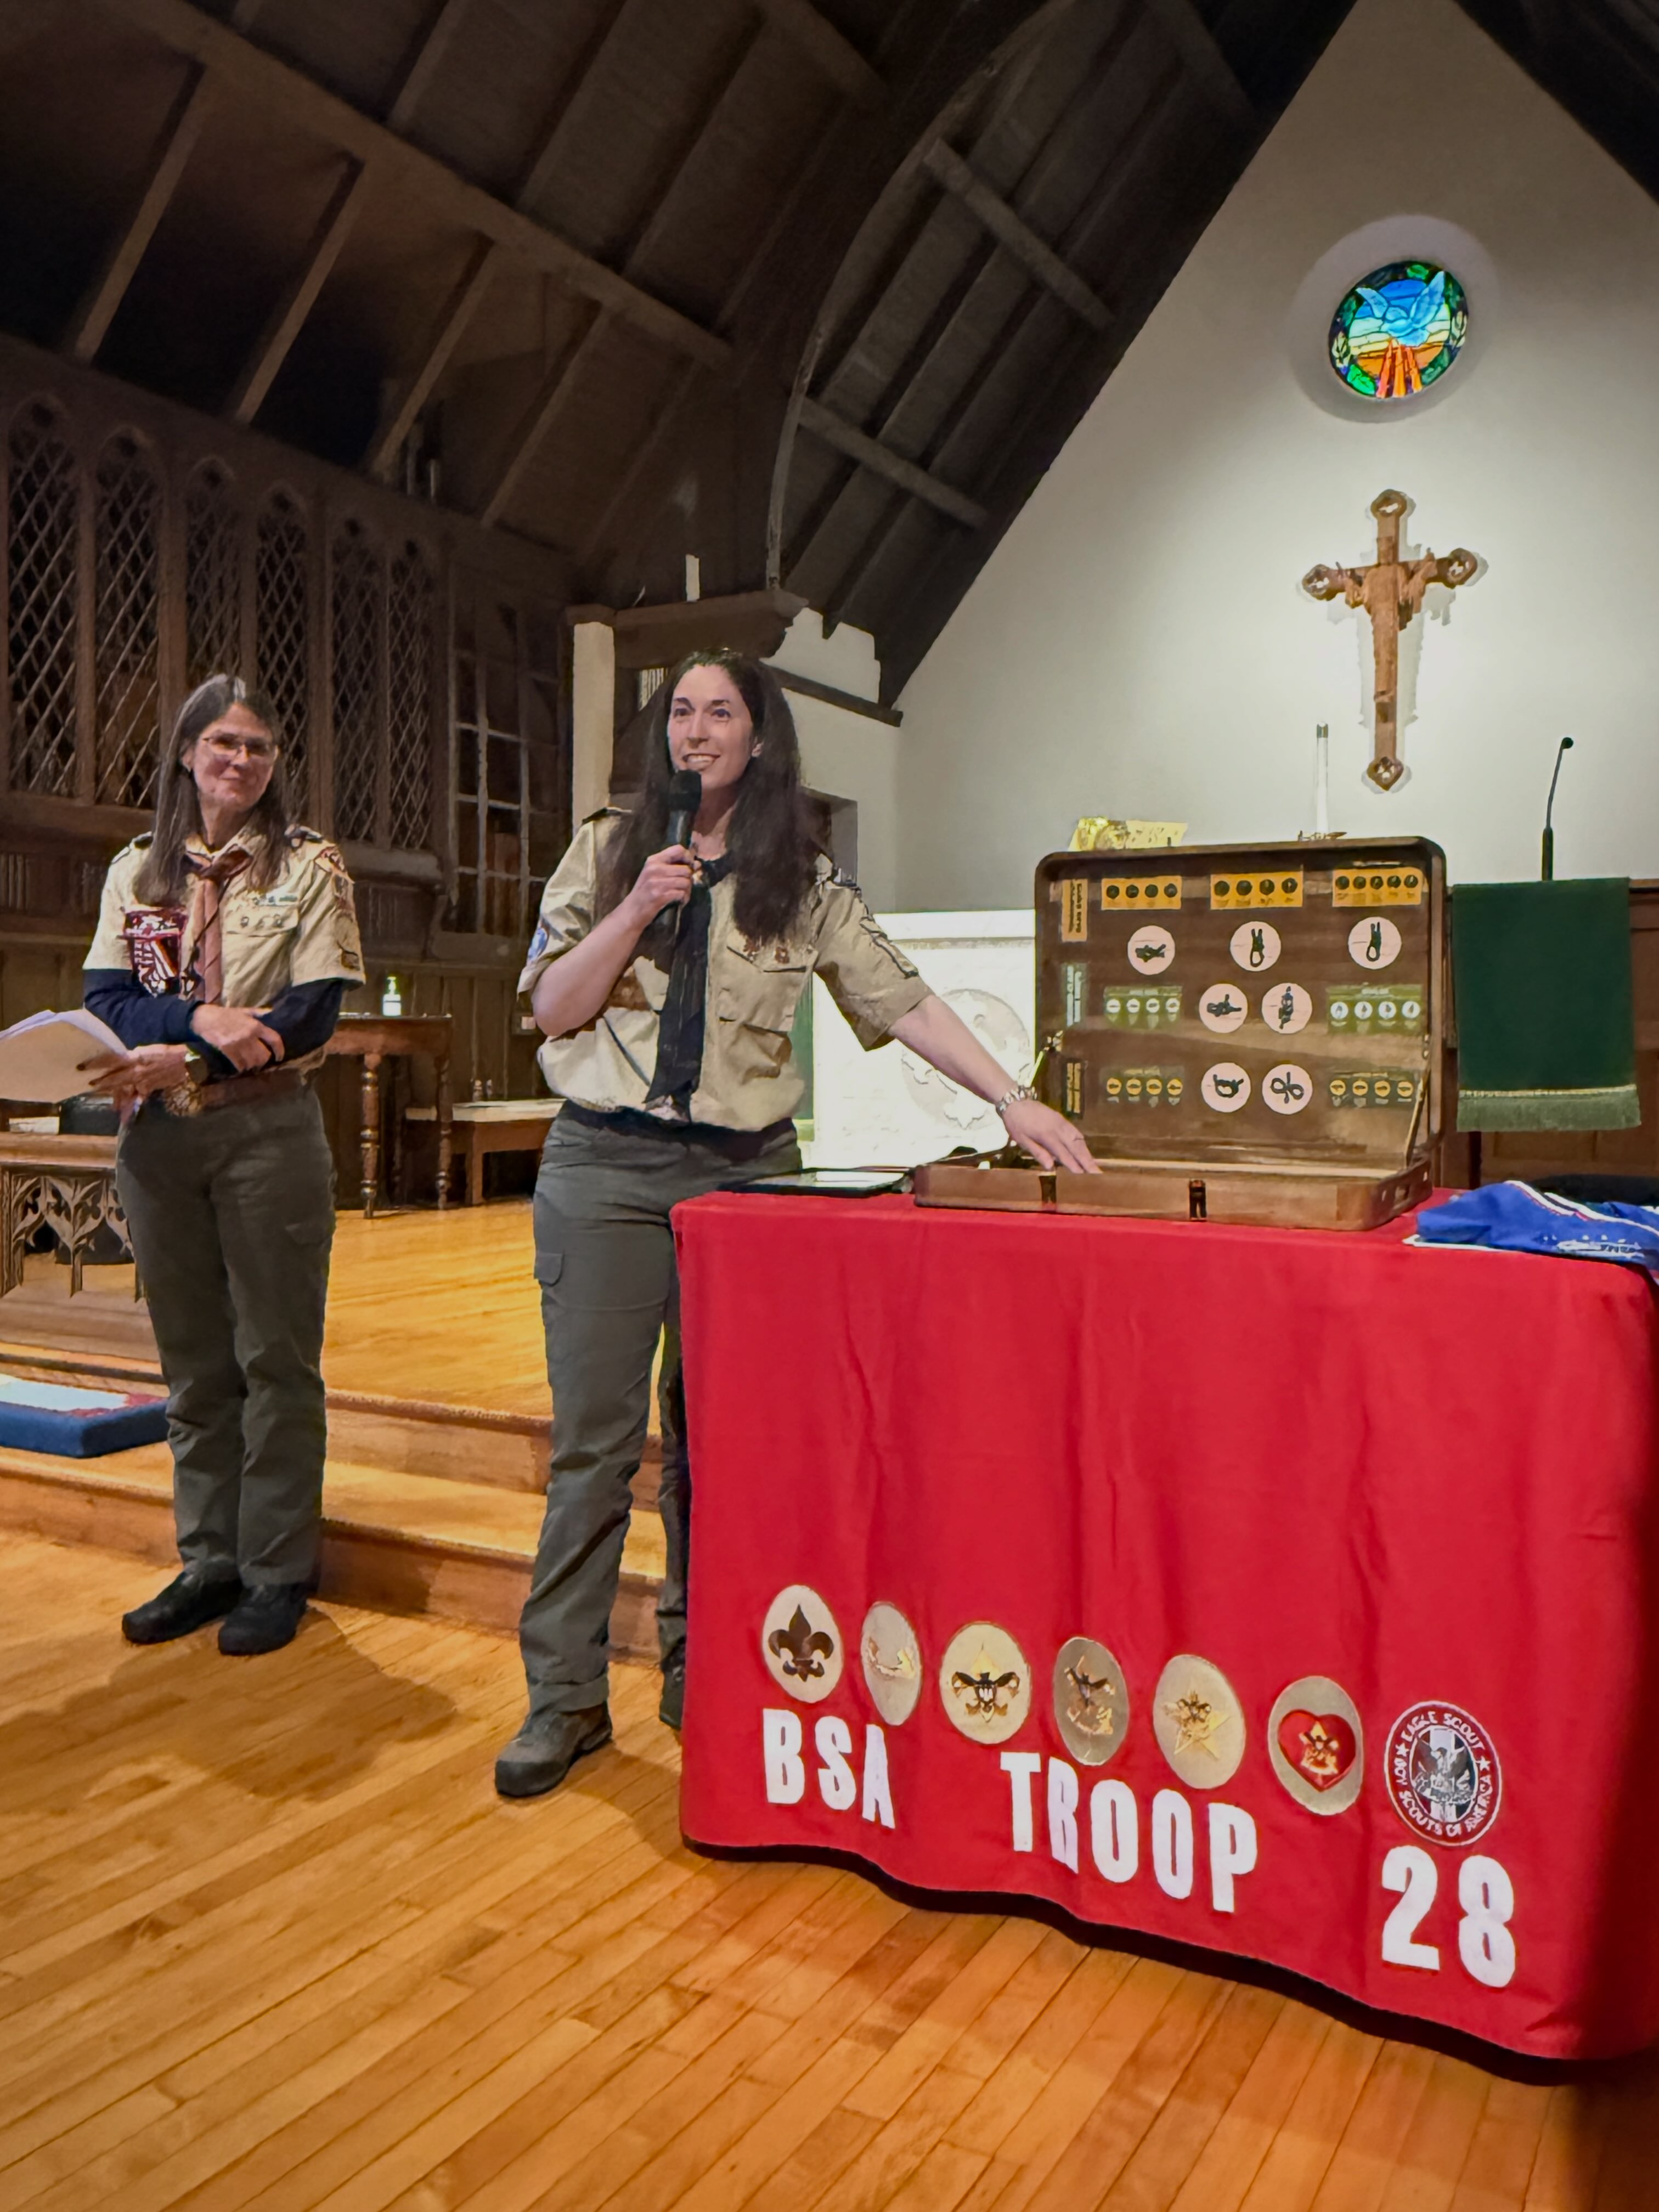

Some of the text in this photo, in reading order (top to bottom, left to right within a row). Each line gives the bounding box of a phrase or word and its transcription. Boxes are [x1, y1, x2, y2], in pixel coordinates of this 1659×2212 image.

[1401, 1711, 1486, 1750] EAGLE SCOUT
[1400, 1790, 1443, 1836] SCOUTS
[763, 1708, 1516, 1988] BSA TROOP 28
